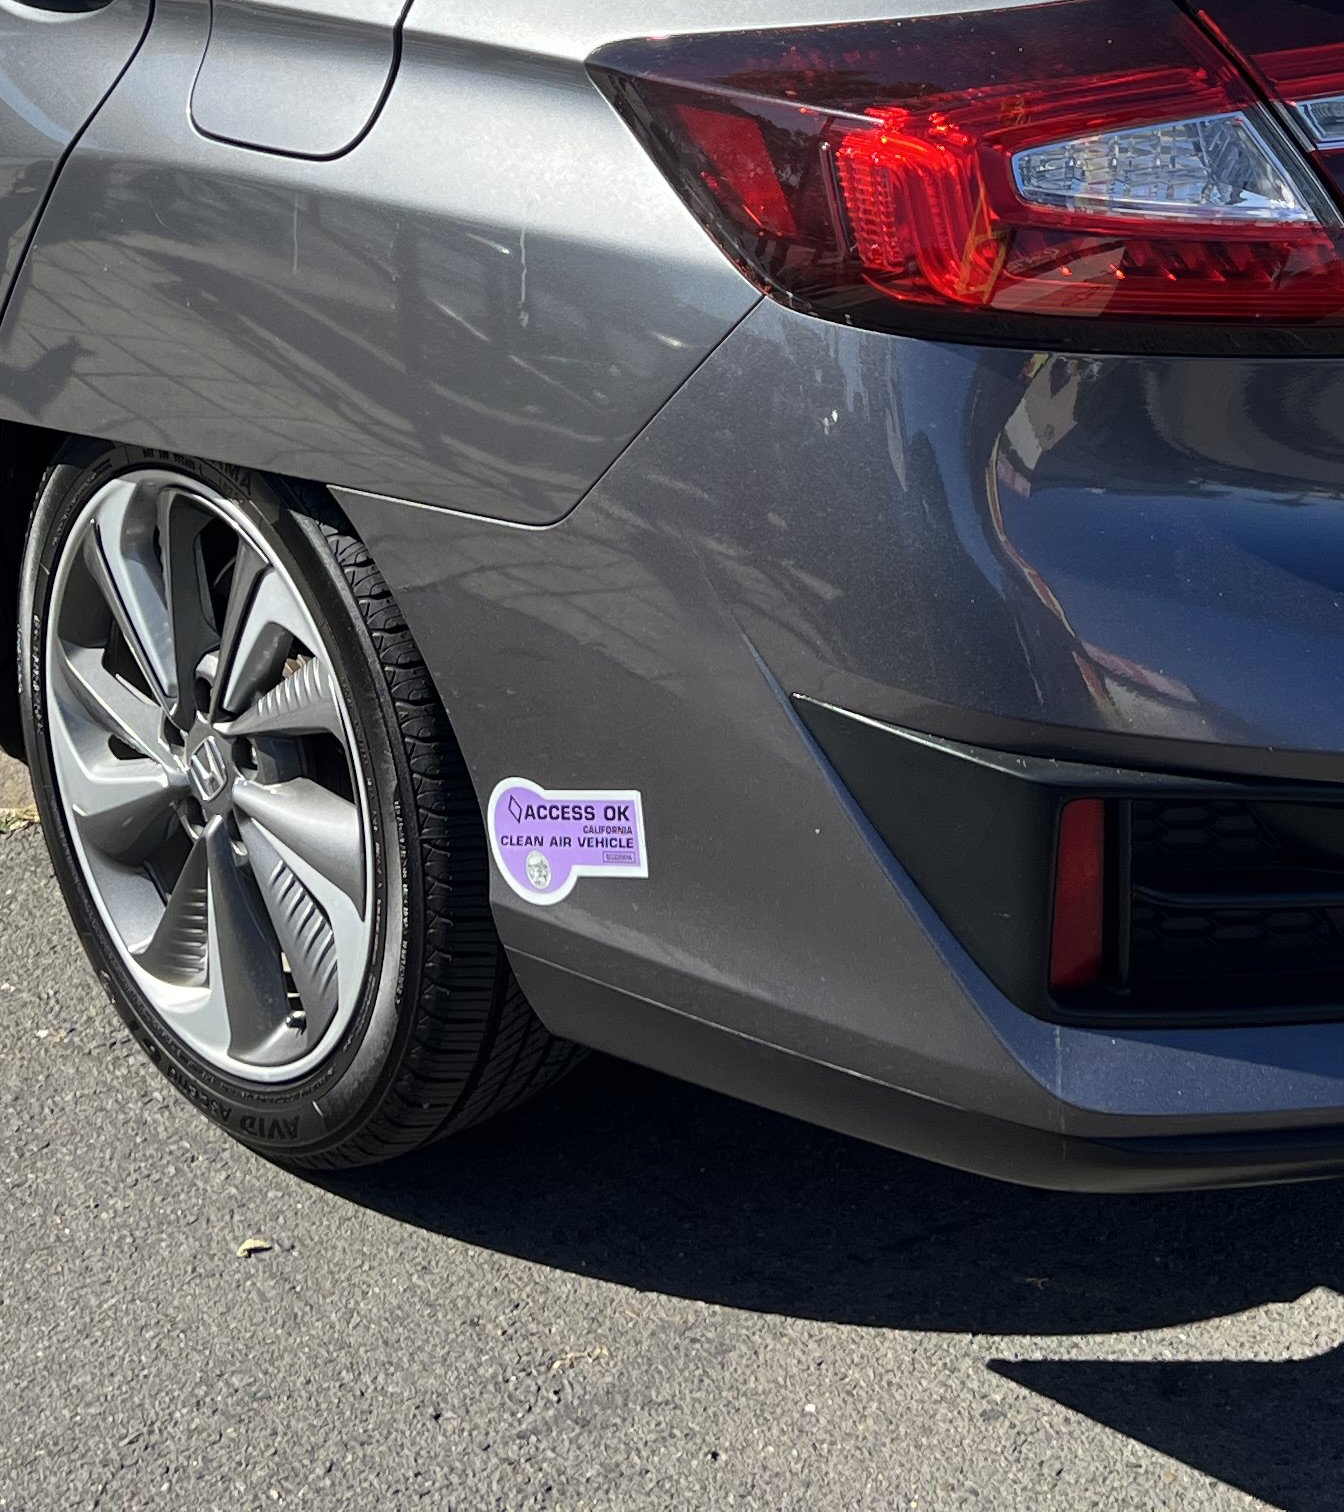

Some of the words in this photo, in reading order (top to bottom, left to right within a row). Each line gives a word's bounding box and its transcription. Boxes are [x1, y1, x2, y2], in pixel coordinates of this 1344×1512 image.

[524, 804, 596, 821] ACCESS
[603, 805, 630, 822] OK
[582, 824, 633, 834] CALIFORNIA
[500, 835, 544, 847] CLEAN
[549, 836, 572, 848] AIR
[577, 837, 634, 849] VEHICLE
